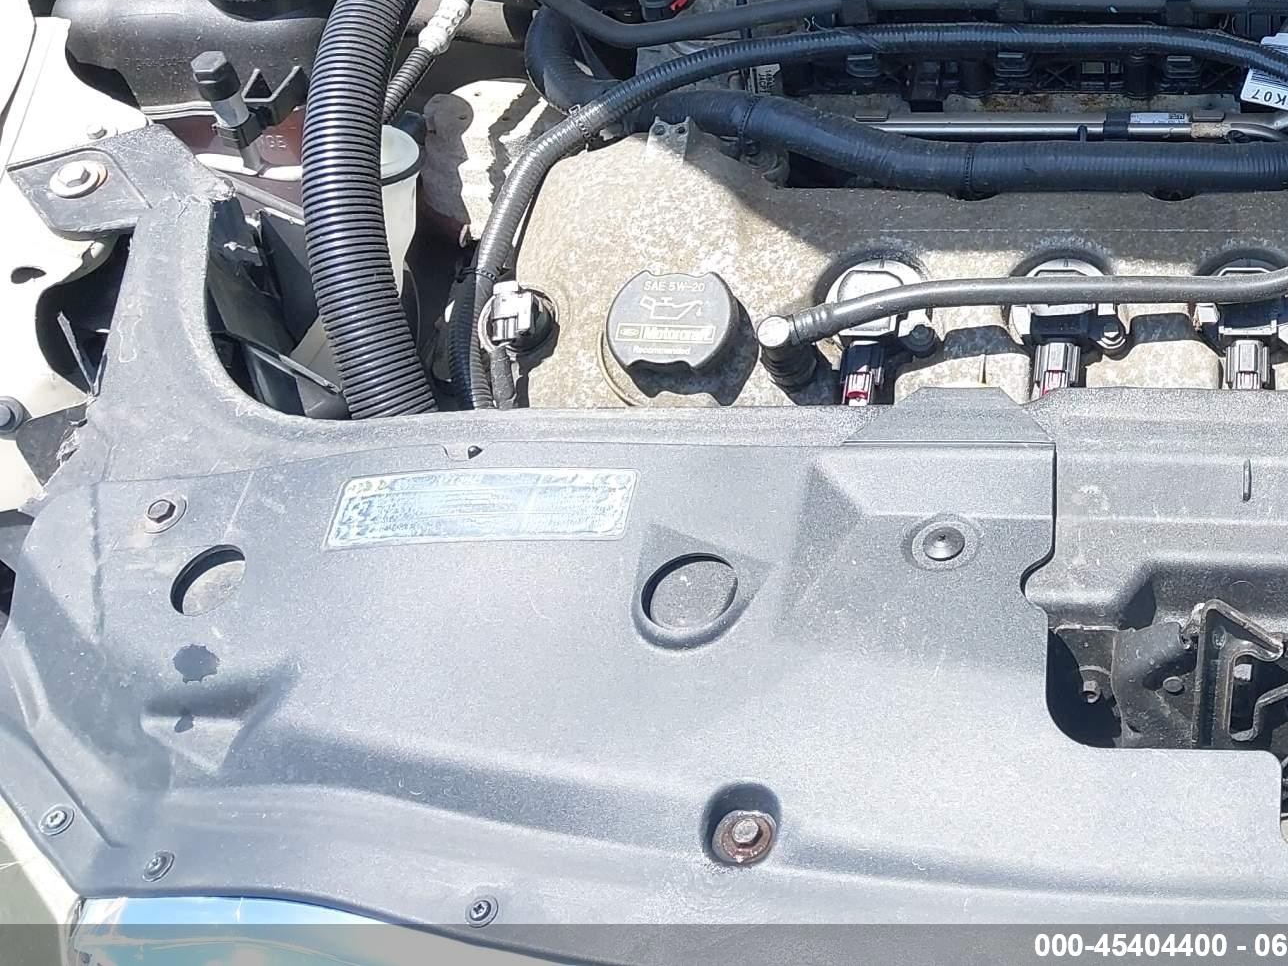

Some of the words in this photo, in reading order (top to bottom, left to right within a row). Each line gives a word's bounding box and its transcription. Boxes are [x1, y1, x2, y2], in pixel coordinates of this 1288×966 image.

[1250, 88, 1287, 106] K07
[643, 280, 667, 292] SAE
[668, 281, 706, 292] 5W-20
